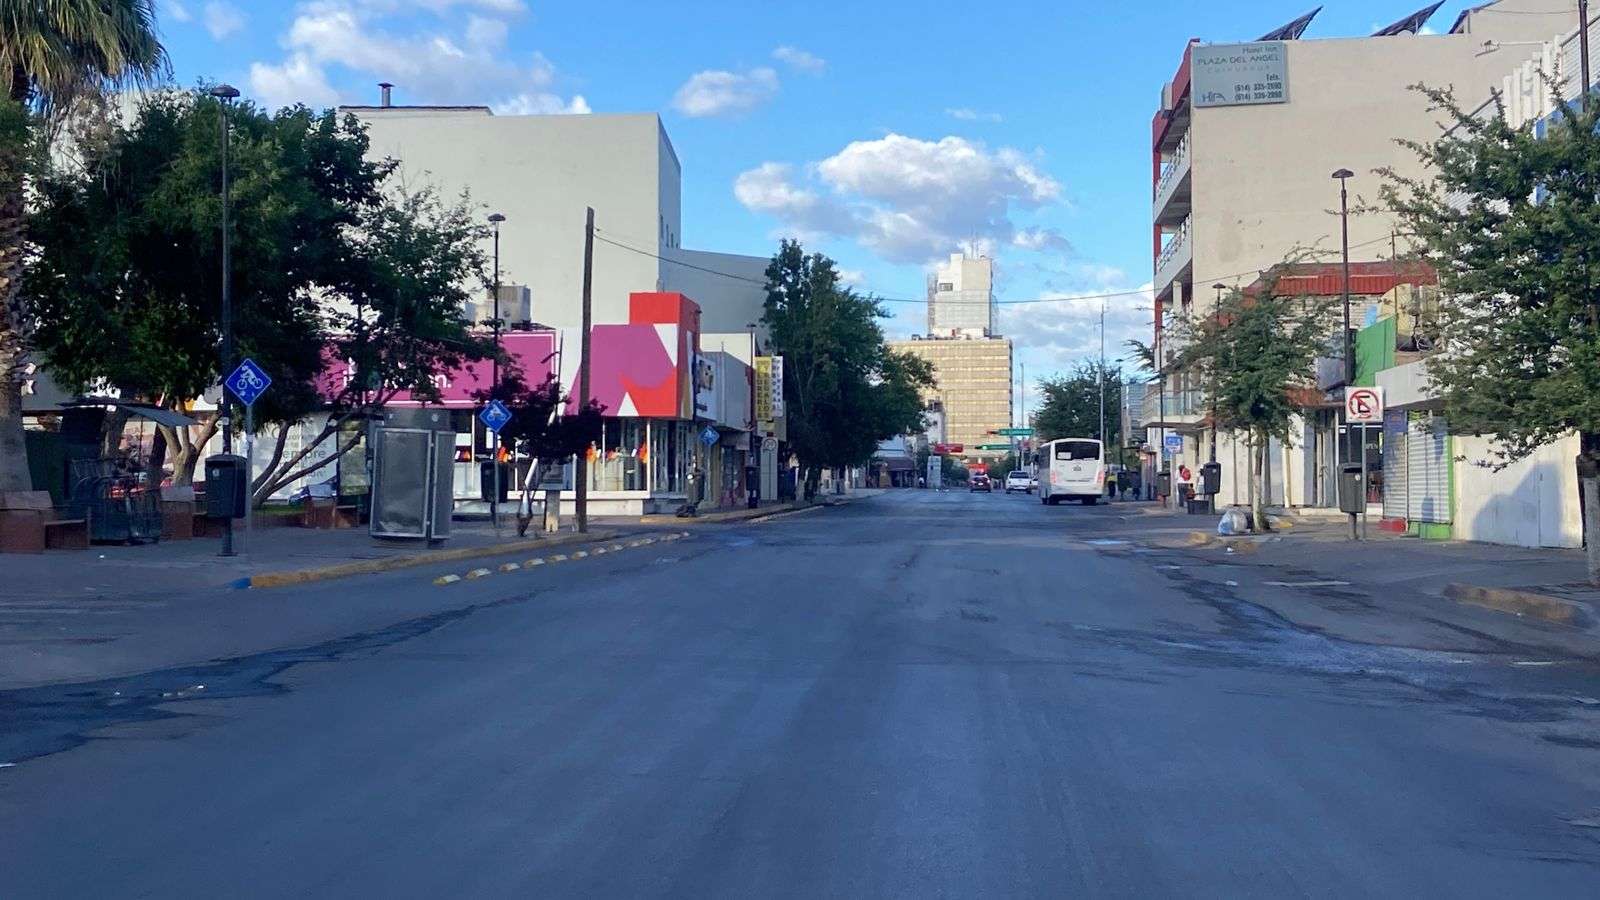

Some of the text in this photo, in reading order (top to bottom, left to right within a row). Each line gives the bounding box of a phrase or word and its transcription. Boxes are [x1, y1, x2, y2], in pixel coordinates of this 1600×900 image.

[1198, 54, 1280, 66] PLAZA DEL ANGEL
